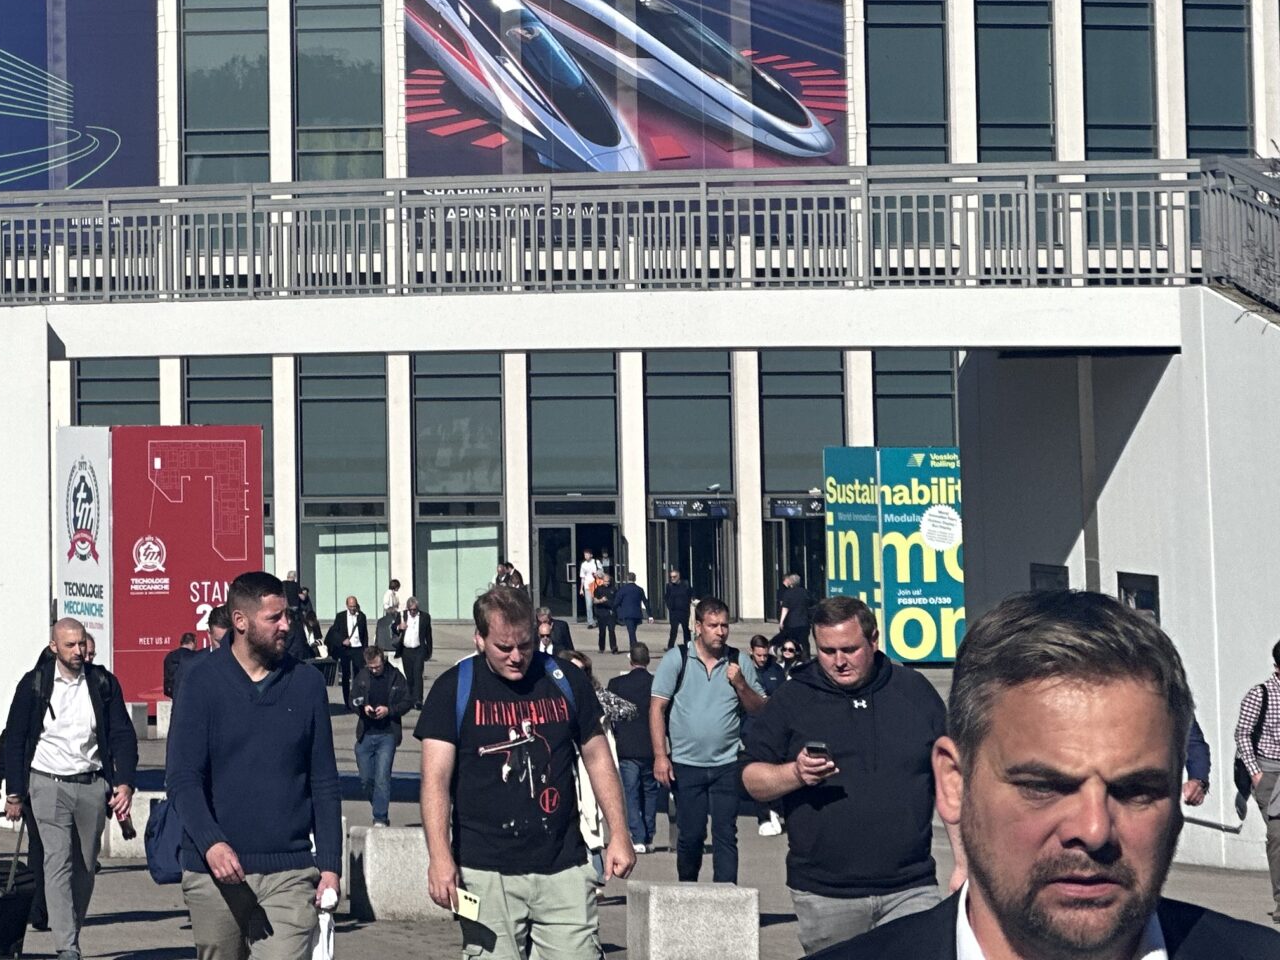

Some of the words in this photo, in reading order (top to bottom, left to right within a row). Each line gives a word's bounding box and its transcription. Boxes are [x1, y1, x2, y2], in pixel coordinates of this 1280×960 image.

[826, 511, 861, 582] in
[64, 581, 104, 599] TECNOLOGIE
[64, 600, 104, 618] MECCANICHE
[139, 637, 154, 645] MEET
